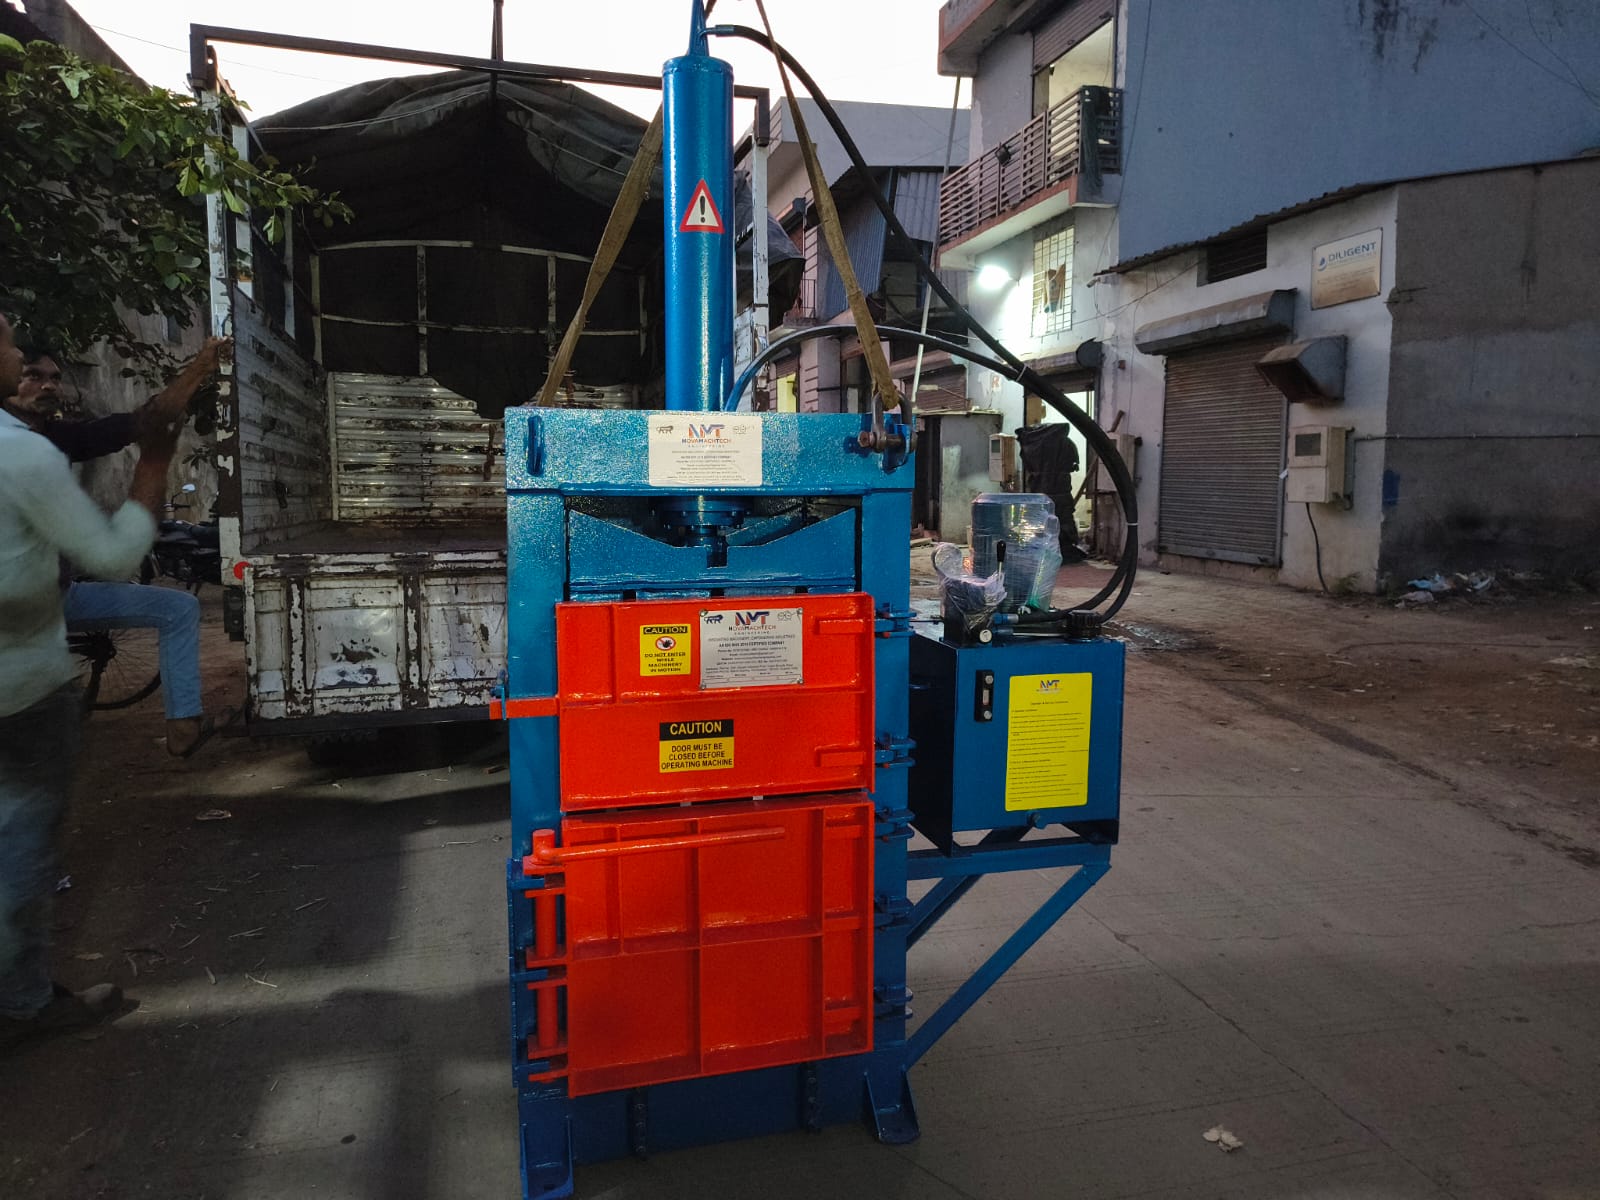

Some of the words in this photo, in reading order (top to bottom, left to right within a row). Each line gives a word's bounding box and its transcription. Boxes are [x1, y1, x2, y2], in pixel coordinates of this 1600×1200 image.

[1328, 241, 1377, 262] DILIGENT
[644, 626, 686, 634] CAUTION
[669, 721, 722, 735] CAUTION
[671, 745, 692, 753] DOOR
[693, 743, 711, 751] MUST
[713, 742, 723, 750] BE
[669, 752, 696, 761] CLOSED
[698, 751, 725, 759] BEFORE
[661, 760, 701, 770] OPERATING
[701, 758, 733, 767] MACHINE
